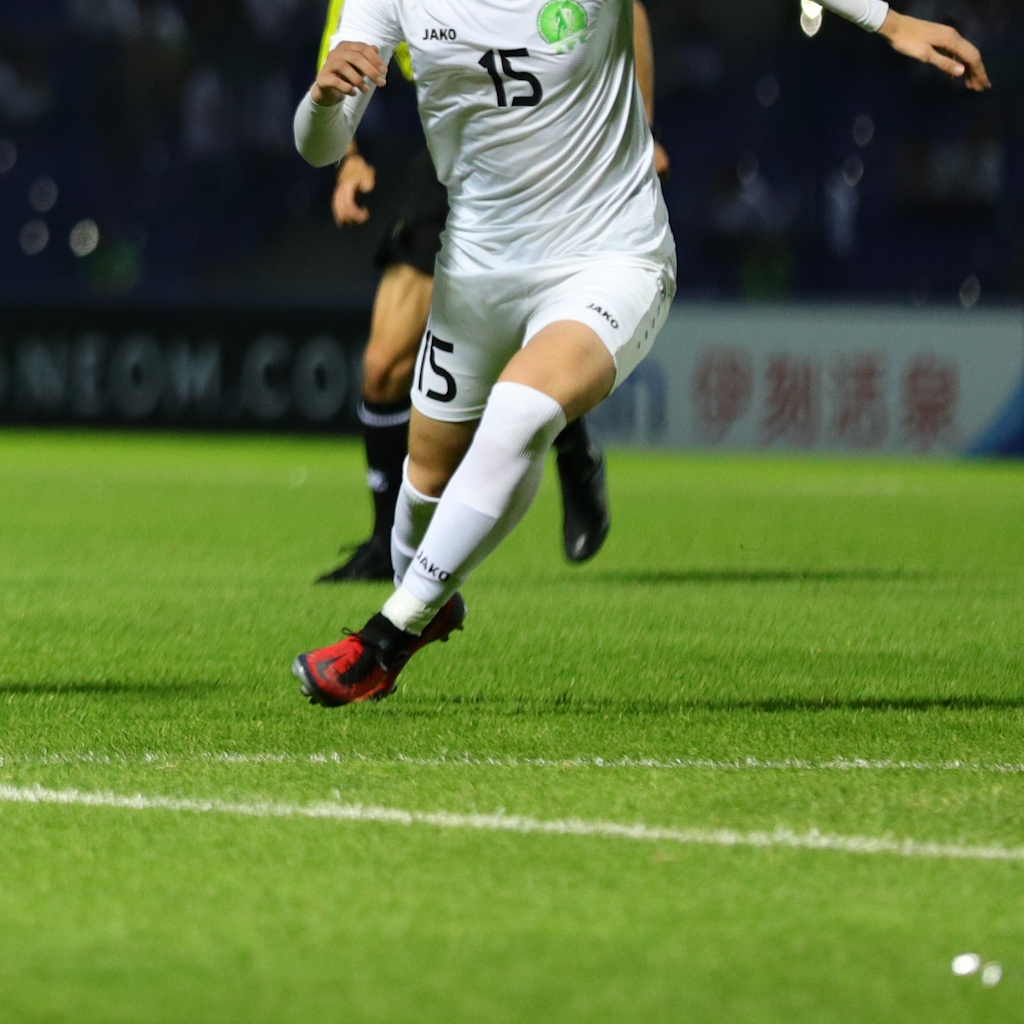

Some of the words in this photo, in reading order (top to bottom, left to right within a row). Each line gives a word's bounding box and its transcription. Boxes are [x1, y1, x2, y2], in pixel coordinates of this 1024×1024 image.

[422, 28, 457, 41] JAKO
[478, 47, 543, 107] 15
[585, 303, 619, 330] JAKO
[416, 550, 451, 582] JAKO
